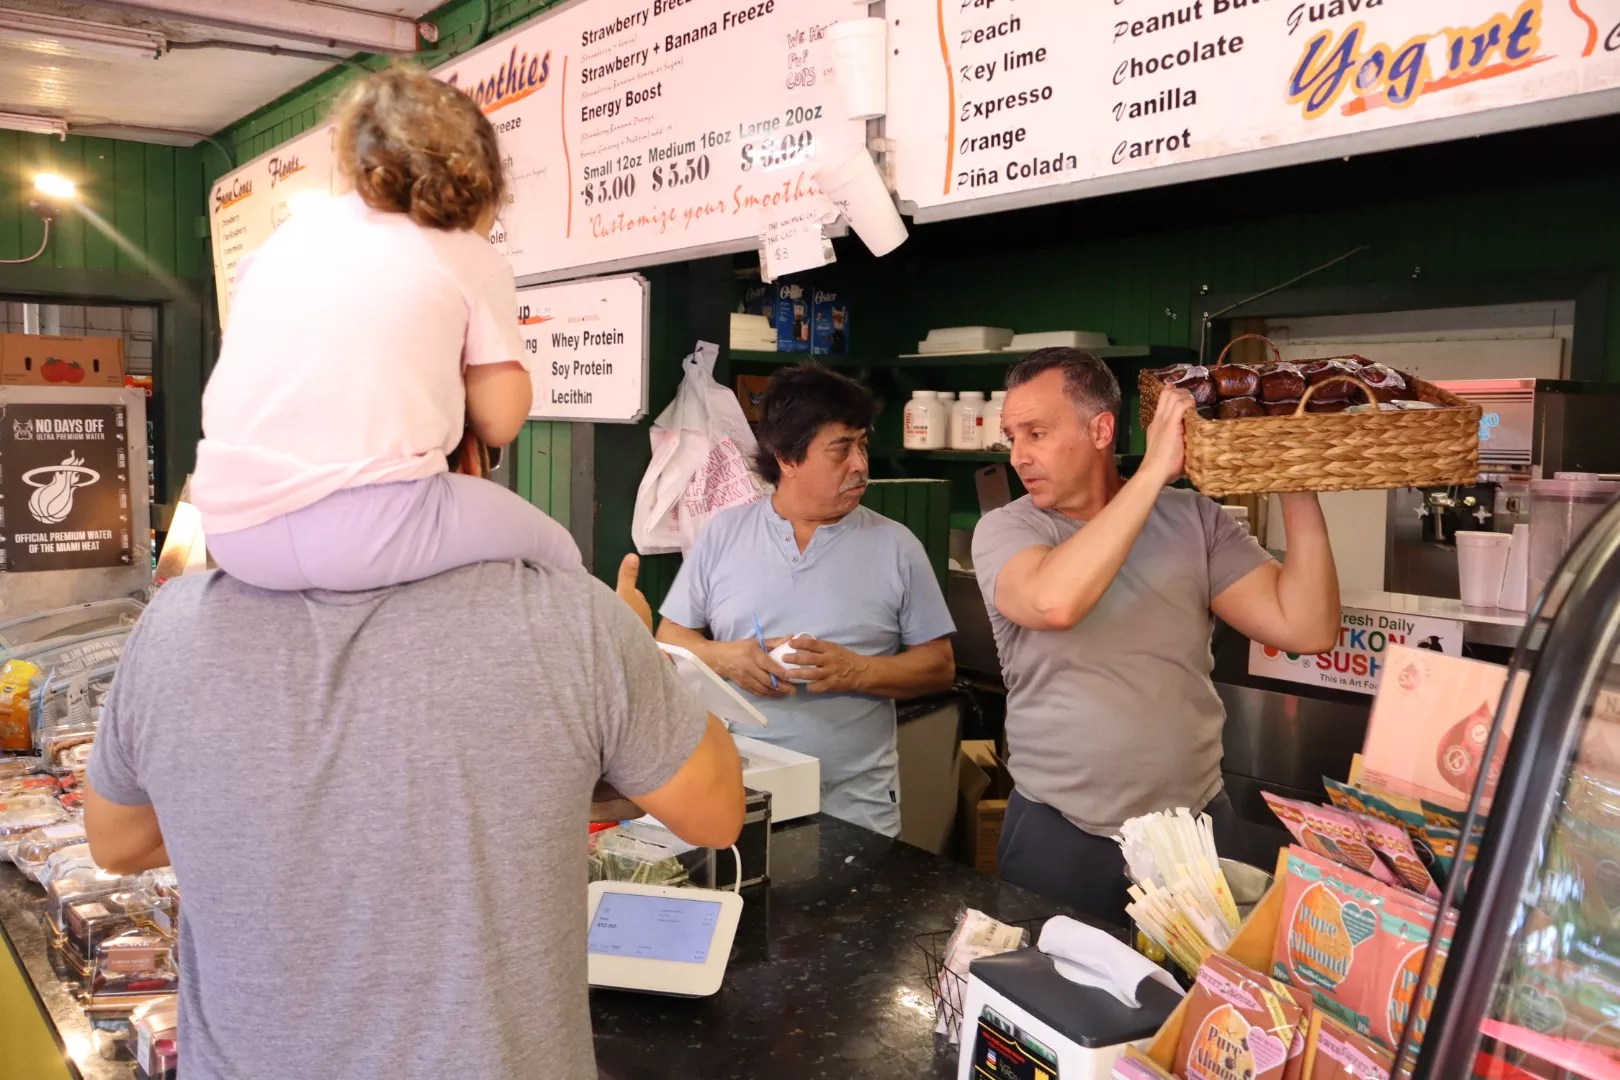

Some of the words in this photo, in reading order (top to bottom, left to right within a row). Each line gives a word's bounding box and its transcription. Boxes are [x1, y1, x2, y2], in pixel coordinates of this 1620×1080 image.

[581, 8, 649, 47] Strawberry
[960, 14, 1021, 49] Peach
[1113, 1, 1203, 46] Peanut
[581, 48, 649, 84] Strawberry
[653, 42, 660, 54] +
[665, 21, 718, 52] Banana
[722, 0, 775, 31] Freeze
[960, 59, 997, 84] Key
[1003, 47, 1047, 72] lime
[1112, 35, 1244, 86] Chocolate
[786, 67, 817, 90] CUPS
[581, 97, 622, 122] Energy
[625, 81, 662, 108] Boost
[960, 84, 1053, 122] Expresso
[1112, 88, 1197, 123] Vanilla
[583, 161, 613, 181] Small
[616, 153, 642, 171] 12oz
[648, 140, 696, 164] Medium
[700, 129, 732, 151] 16oz
[739, 117, 780, 139] Large
[785, 105, 822, 128] 20oz
[959, 125, 1026, 155] Orange
[1111, 127, 1191, 166] Carrot
[957, 167, 999, 191] Piña
[1006, 151, 1078, 182] Colada
[682, 199, 726, 230] your
[551, 332, 580, 351] Whey
[583, 328, 624, 346] Protein
[551, 360, 570, 379] Soy
[573, 358, 613, 376] Protein
[551, 388, 593, 404] Lecithin
[35, 418, 50, 433] NO
[54, 418, 83, 433] DAYS
[86, 418, 105, 433] OFF
[36, 433, 55, 441] ULTRA
[56, 433, 84, 441] PREMIUM
[85, 433, 105, 441] WATER
[15, 532, 49, 544] OFFICIAL
[50, 531, 86, 542] PREMIUM
[87, 530, 112, 541] WATER
[29, 544, 39, 554] OF
[40, 543, 55, 553] THE
[56, 542, 81, 552] MIAMI
[82, 541, 100, 551] HEAT
[1341, 610, 1374, 627] resh
[1379, 615, 1415, 635] Daily
[1315, 650, 1385, 678] SUSH
[1320, 673, 1338, 683] This
[1340, 676, 1347, 685] is
[1349, 678, 1362, 688] Art
[1289, 929, 1348, 977] Almond
[1207, 1023, 1243, 1060] Pure
